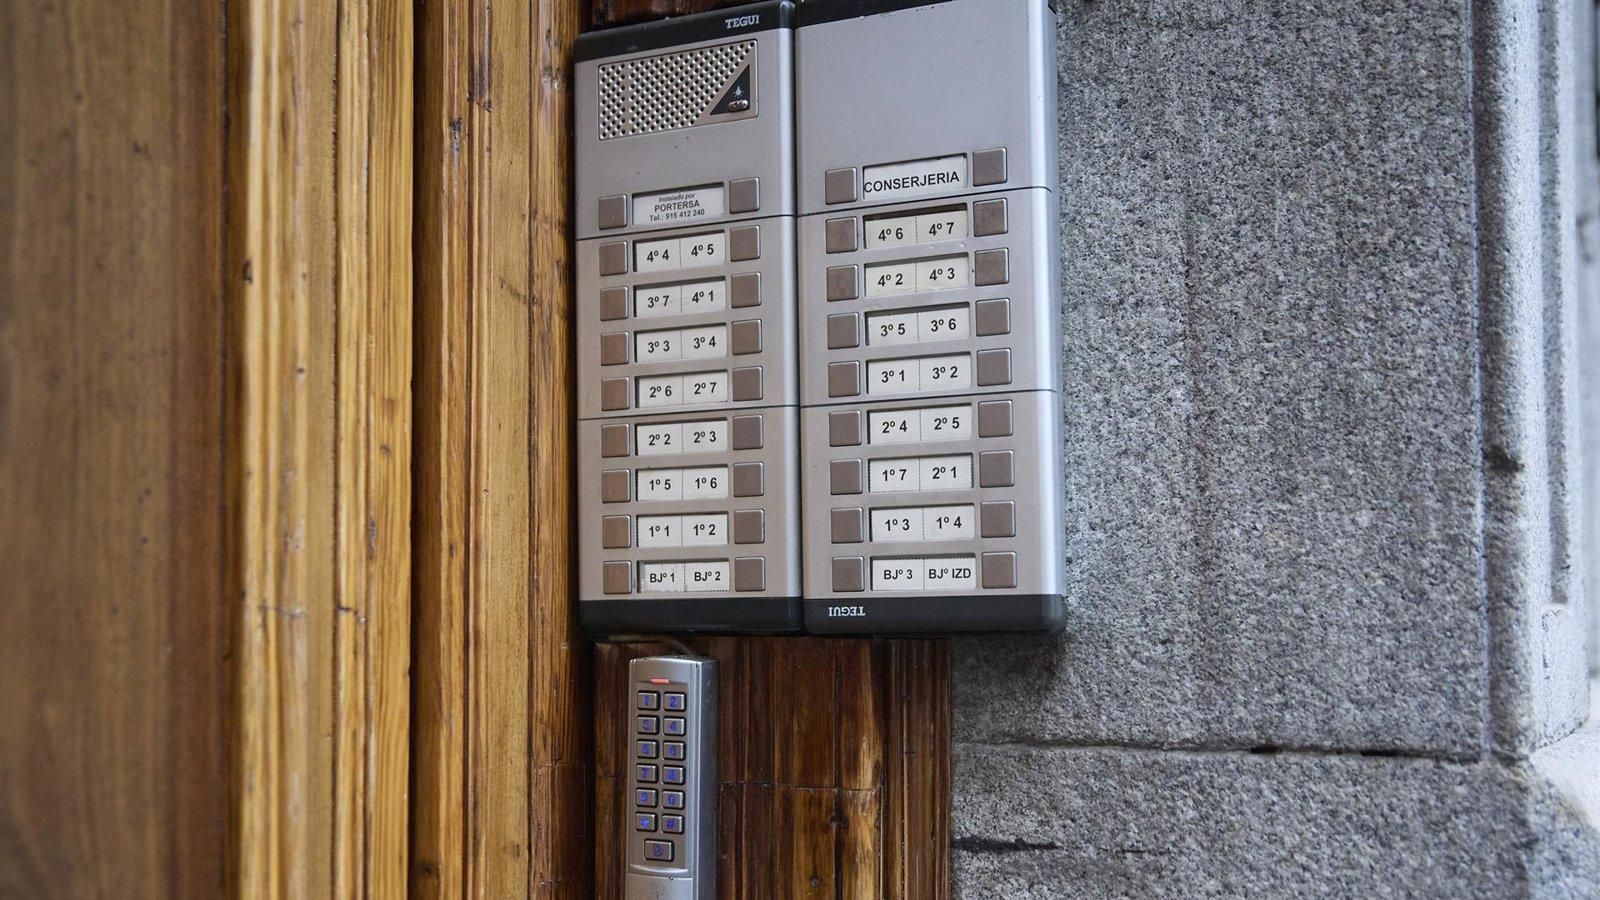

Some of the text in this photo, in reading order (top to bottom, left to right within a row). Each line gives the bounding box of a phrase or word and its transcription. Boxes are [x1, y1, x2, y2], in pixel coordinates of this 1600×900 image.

[725, 15, 760, 29] TEGUI
[864, 171, 960, 193] CONSERJERIA
[654, 200, 700, 212] PORTERSA
[896, 228, 903, 239] 6
[946, 222, 954, 234] 7
[662, 249, 669, 260] 4
[708, 244, 714, 255] 5
[948, 268, 954, 279] 3
[896, 274, 902, 285] 2
[663, 296, 669, 306] 7
[709, 290, 713, 301] 1
[898, 323, 905, 335] 5
[949, 318, 956, 330] 6
[664, 340, 670, 352] 3
[709, 336, 716, 347] 4
[899, 370, 904, 381] 1
[950, 366, 957, 378] 2
[665, 386, 672, 396] 6
[710, 382, 716, 393] 7
[900, 420, 907, 432] 4
[952, 417, 959, 428] 5
[664, 434, 670, 444] 2
[710, 431, 716, 442] 3
[900, 469, 906, 480] 7
[951, 466, 956, 478] 1
[664, 479, 671, 490] 5
[710, 478, 717, 488] 6
[903, 519, 909, 530] 3
[954, 516, 962, 528] 4
[664, 526, 669, 536] 1
[709, 524, 715, 535] 2
[670, 573, 674, 582] 1
[715, 571, 720, 580] 2
[907, 569, 912, 579] 3
[952, 568, 971, 578] IZD
[828, 606, 866, 617] TEGUI
